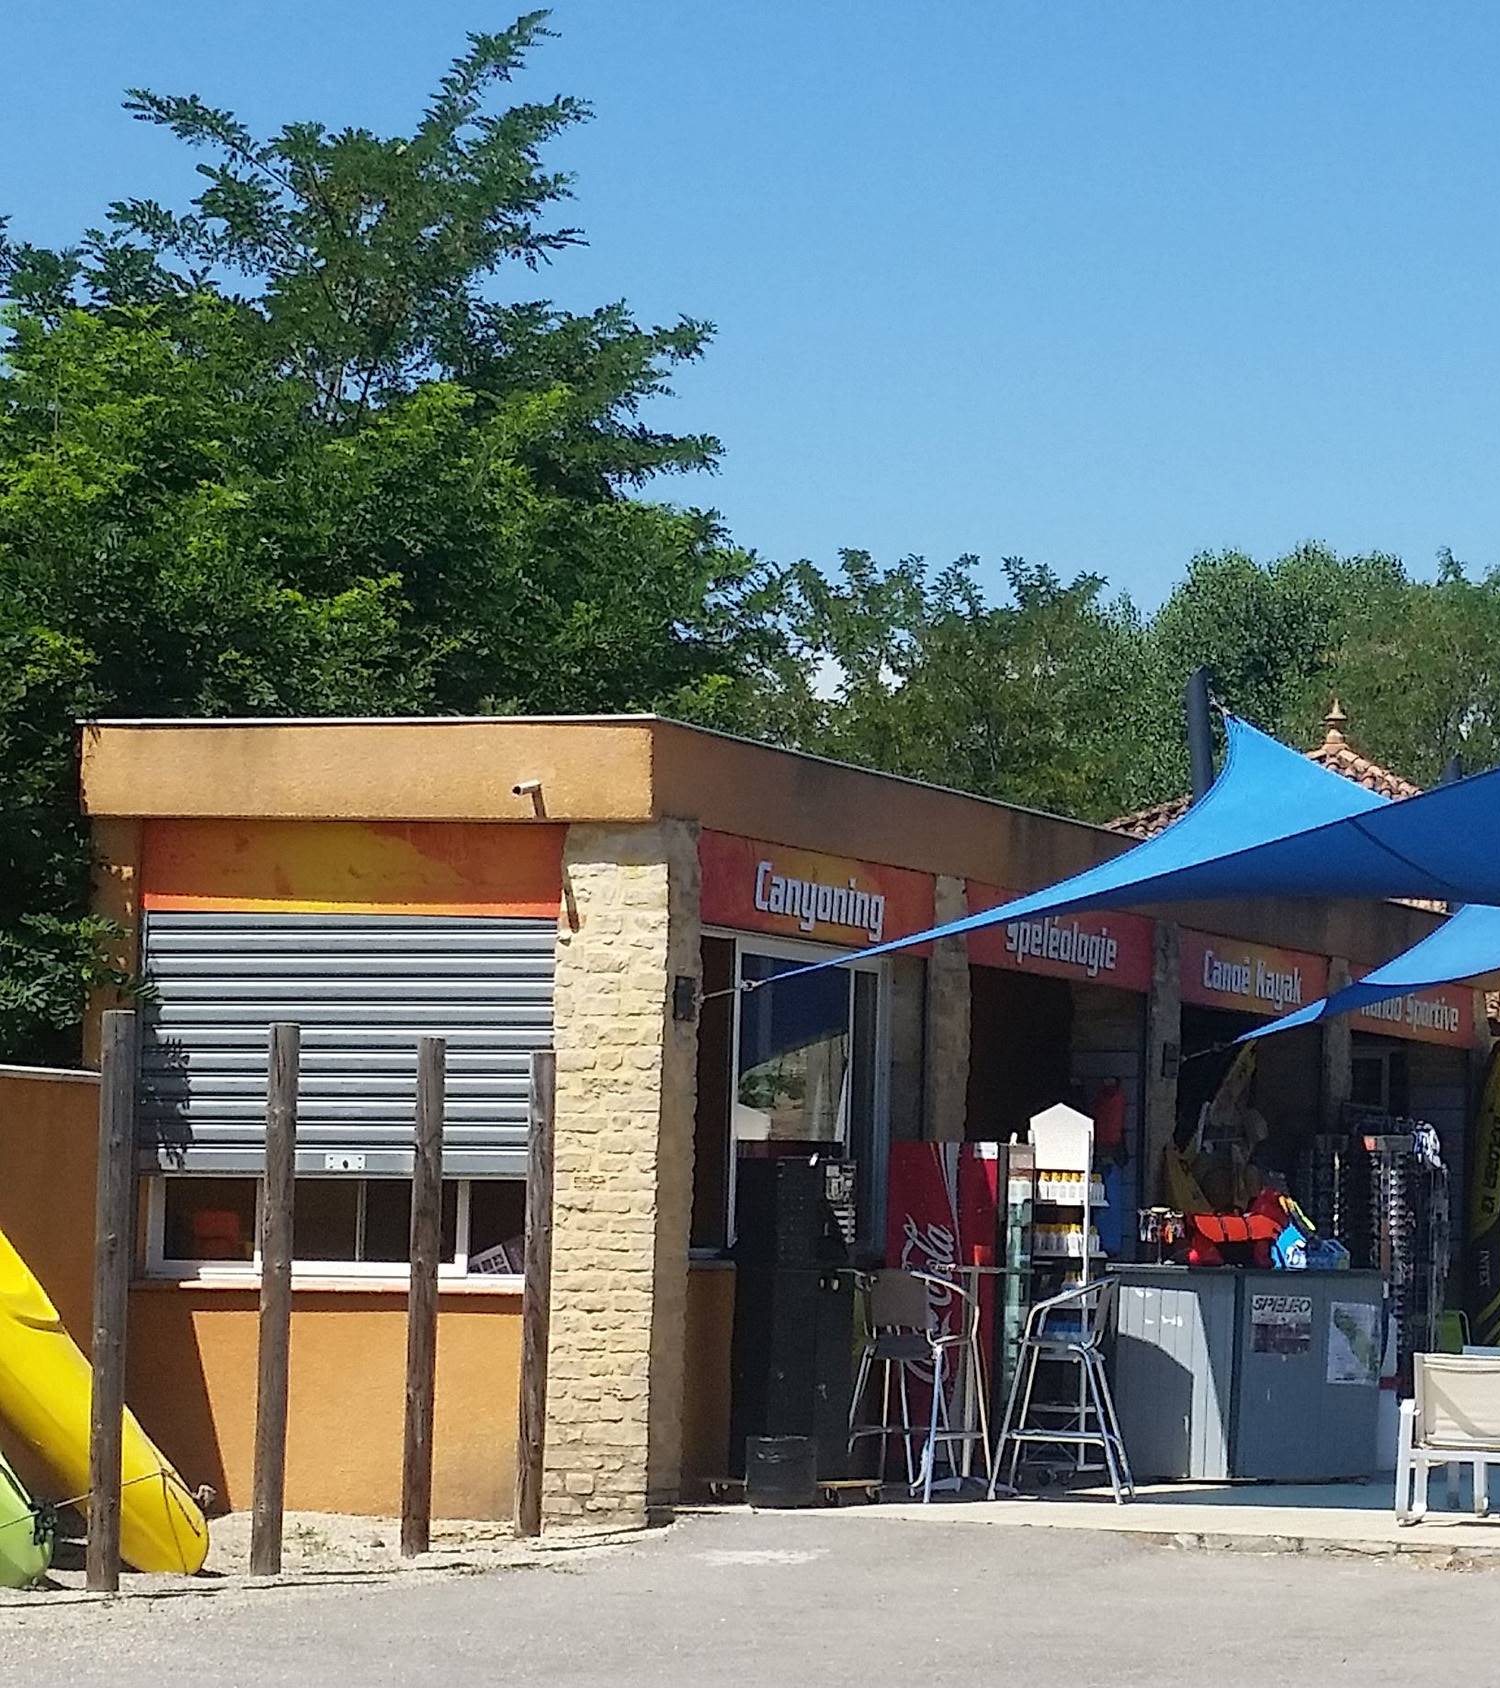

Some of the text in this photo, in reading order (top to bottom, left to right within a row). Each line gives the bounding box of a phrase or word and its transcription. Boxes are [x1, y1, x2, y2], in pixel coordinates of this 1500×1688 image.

[754, 859, 886, 943] Canyoning
[1255, 959, 1303, 1011] Kayak
[1405, 993, 1460, 1032] Sportive
